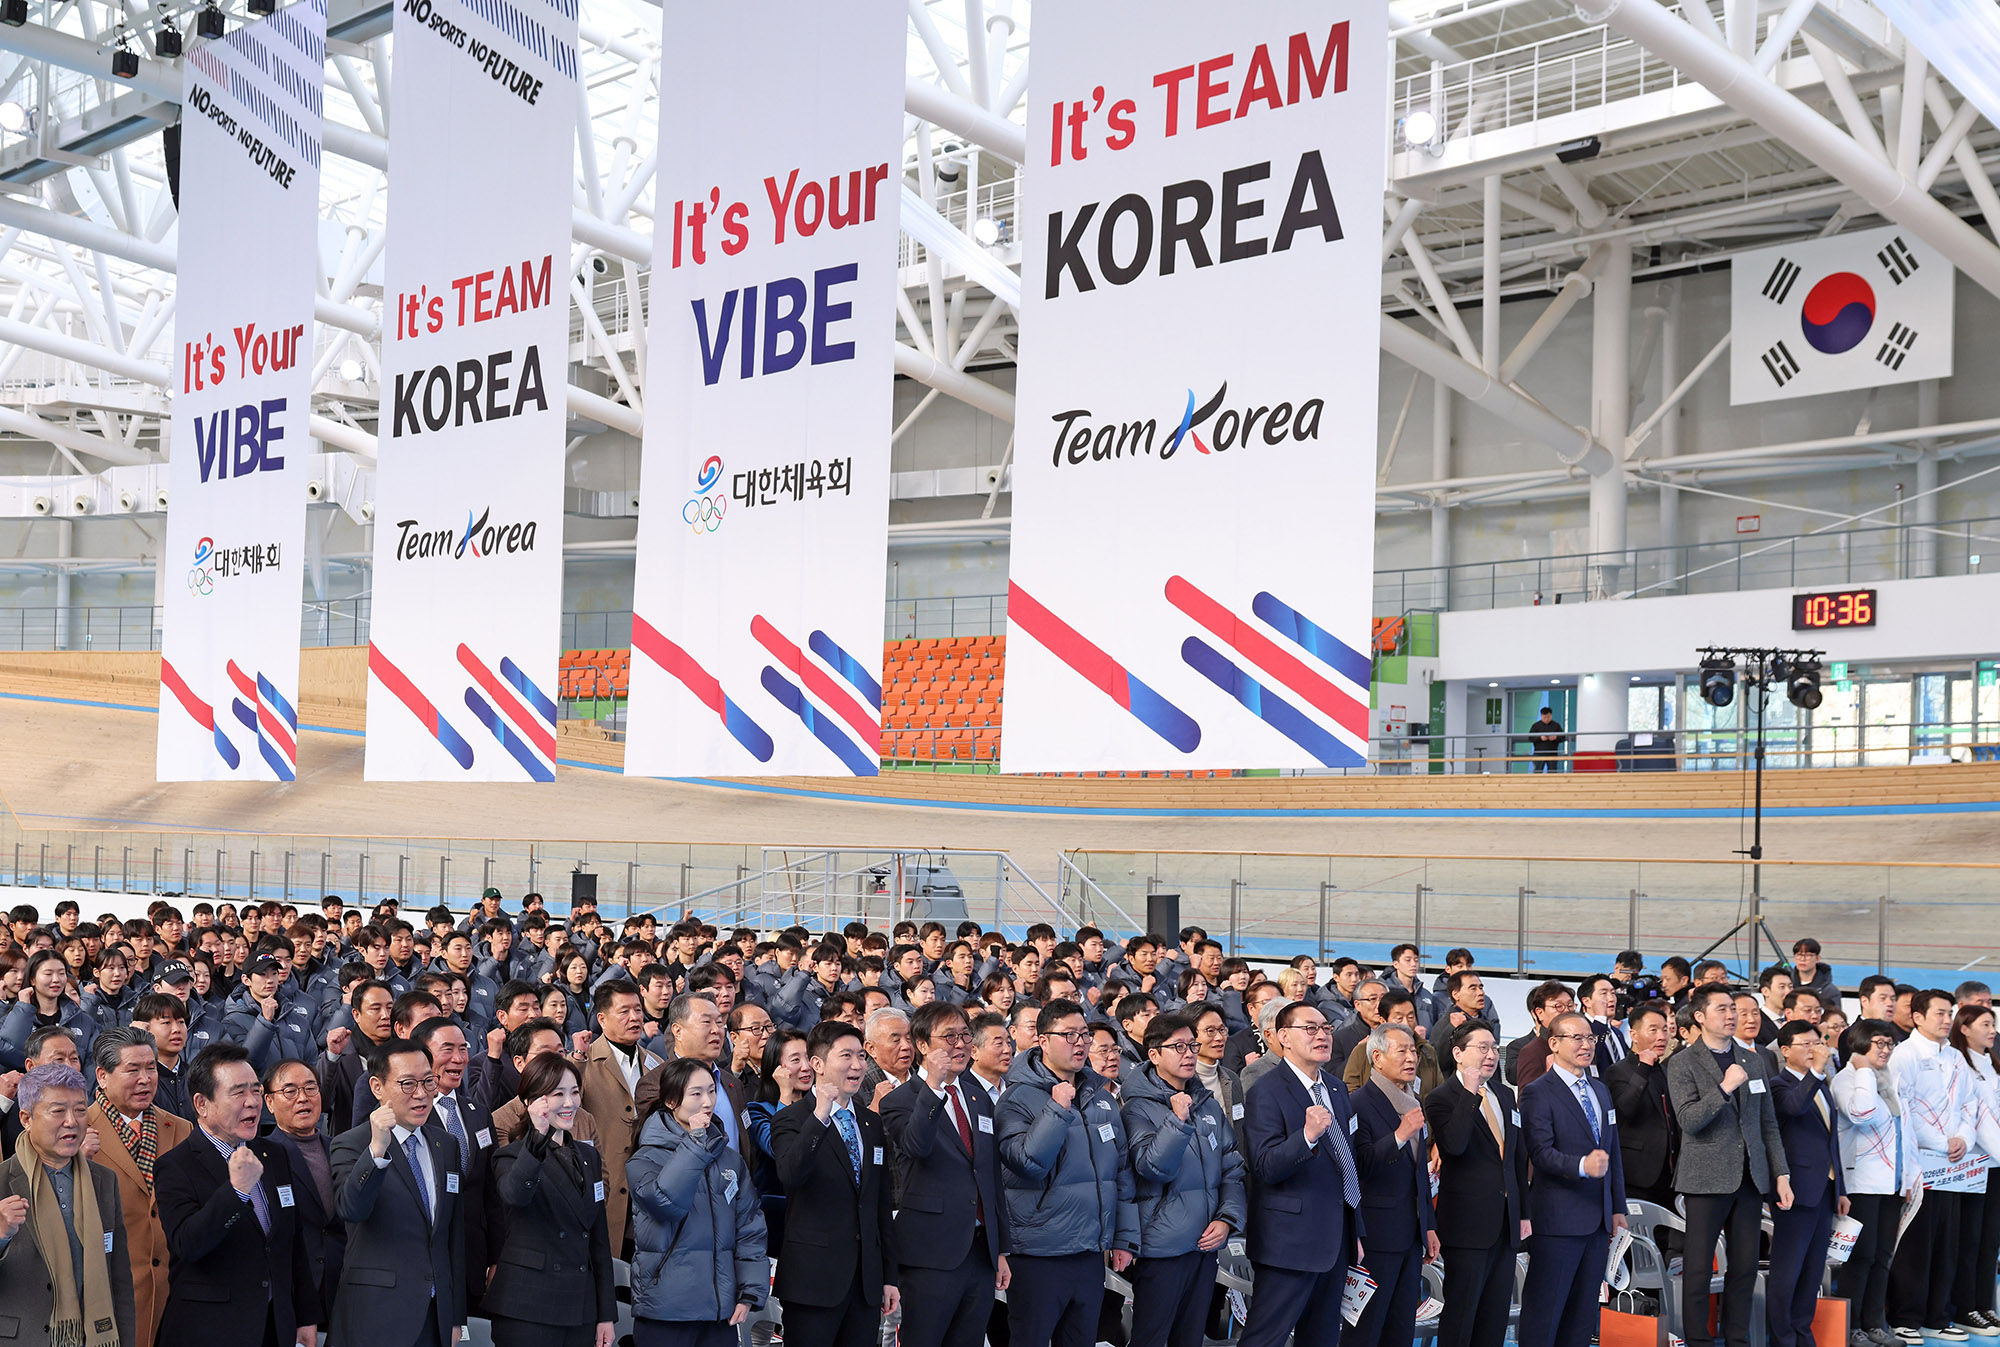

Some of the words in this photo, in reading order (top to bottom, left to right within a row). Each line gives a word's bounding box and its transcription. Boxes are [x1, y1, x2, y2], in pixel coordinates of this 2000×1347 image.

[403, 0, 432, 23] NO
[428, 13, 467, 48] SPORTS
[467, 38, 488, 62] NO
[483, 50, 543, 106] FUTURE
[1050, 85, 1137, 167] It's
[1153, 20, 1350, 138] TEAM
[188, 83, 211, 113] NO
[208, 104, 237, 136] SPORTS
[237, 127, 253, 149] NO
[248, 138, 296, 190] FUTURE
[672, 186, 750, 269] It's
[763, 162, 889, 245] Your
[1045, 150, 1345, 300] KOREA
[396, 284, 444, 341] It's
[451, 254, 552, 327] TEAM
[690, 262, 859, 387] VIBE
[184, 332, 226, 394] It's
[233, 323, 304, 379] Your
[392, 345, 549, 438] KOREA
[194, 397, 287, 484] VIBE
[1051, 409, 1157, 468] Team
[1159, 379, 1325, 460] Korea
[733, 457, 852, 508] 대한체육회
[396, 519, 453, 561] Team
[454, 505, 537, 560] Korea
[1805, 593, 1871, 626] 10:36
[1922, 1168, 1946, 1179] 026년은
